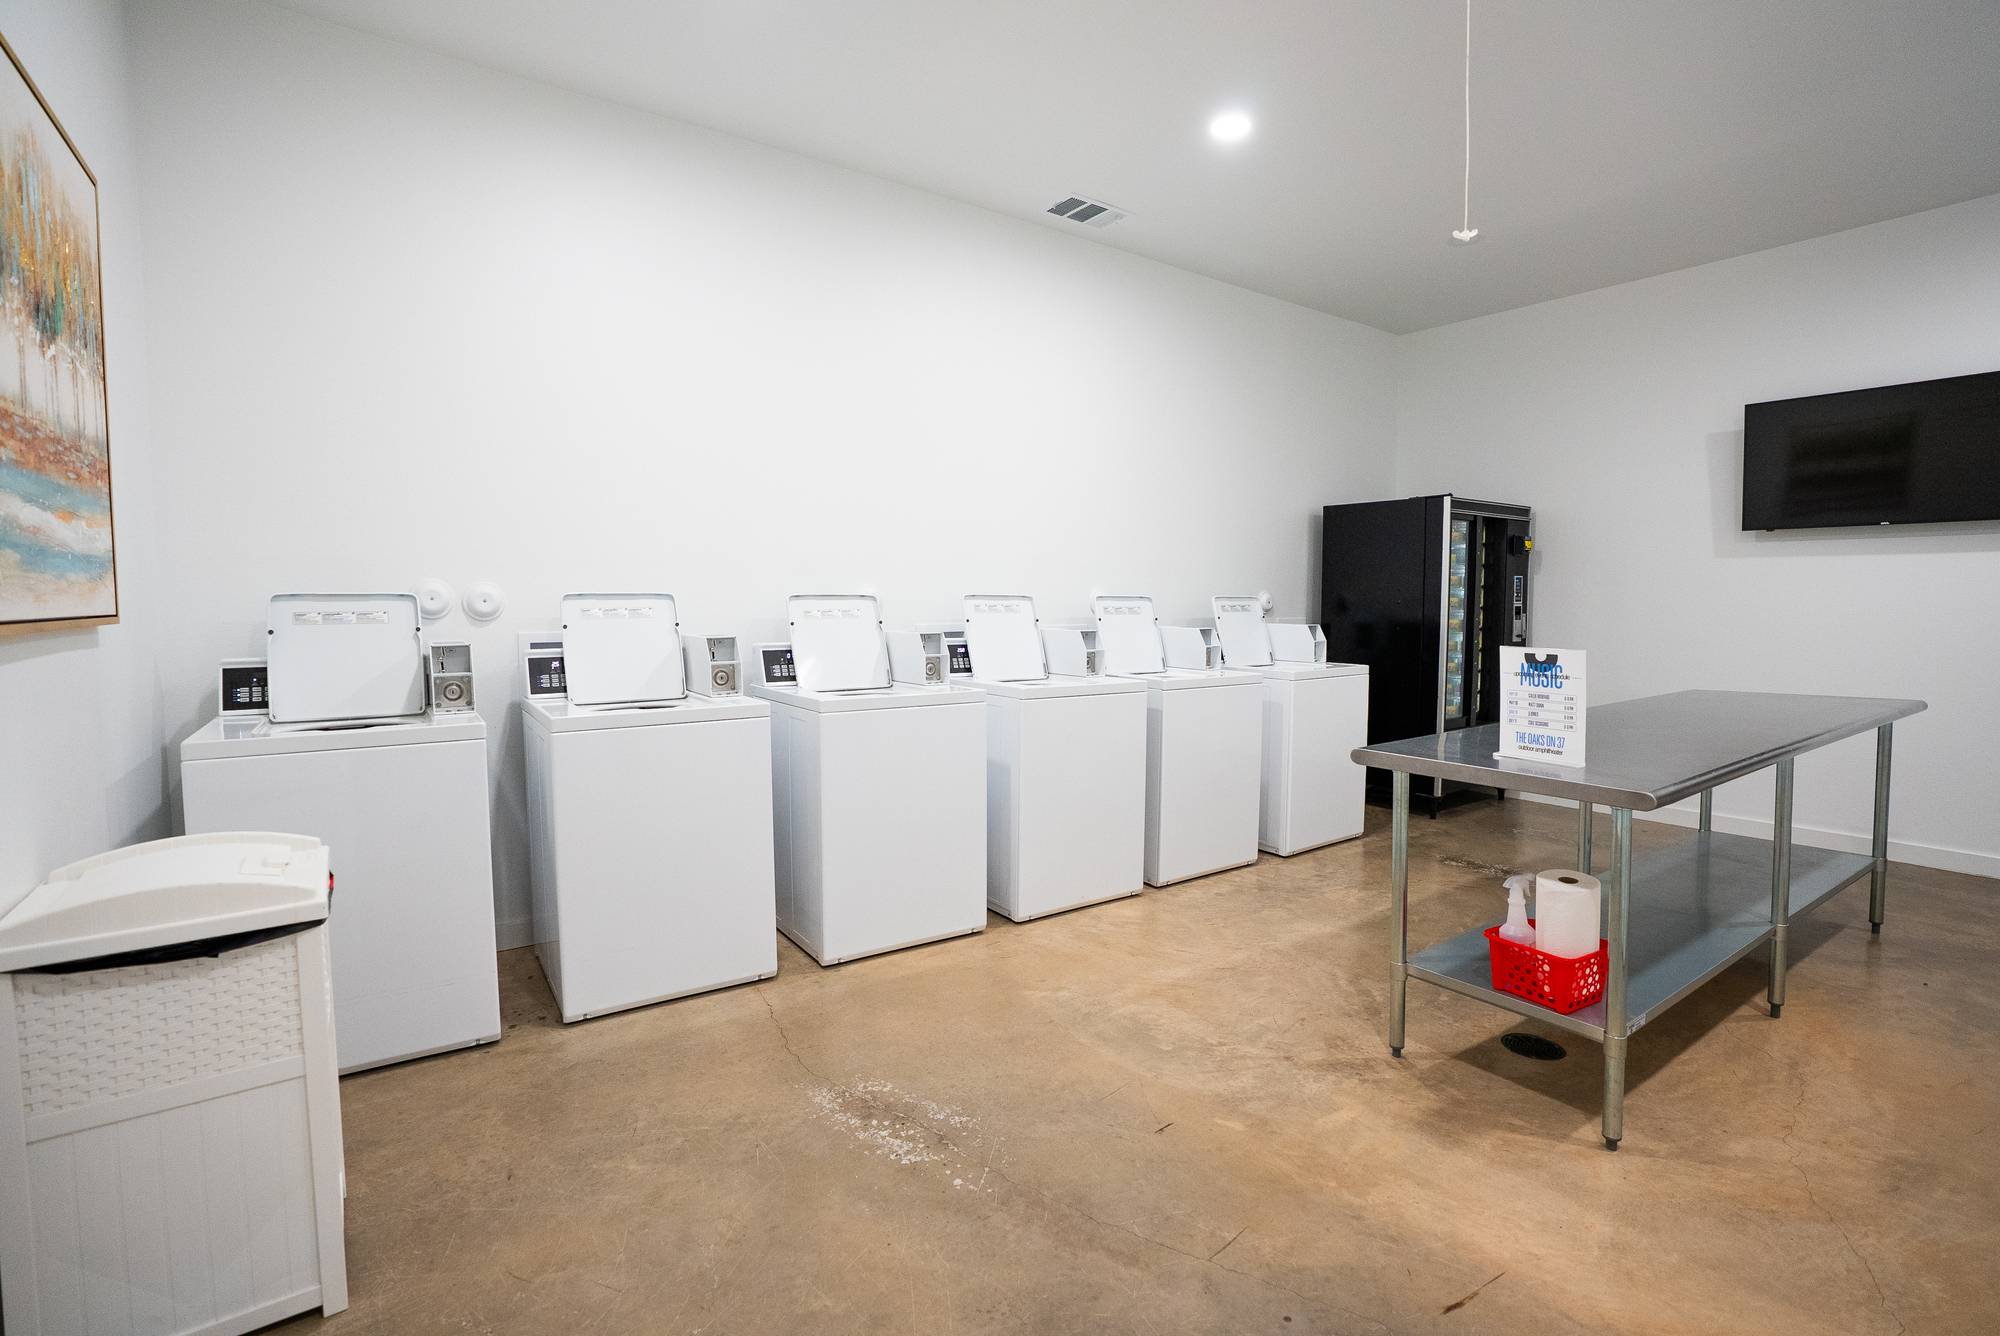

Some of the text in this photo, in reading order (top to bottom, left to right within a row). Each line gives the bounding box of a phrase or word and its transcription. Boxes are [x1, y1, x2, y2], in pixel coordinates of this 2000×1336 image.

[1520, 662, 1563, 689] MUSIC
[1516, 731, 1566, 749] THE OAKS ON 37
[1518, 744, 1563, 756] outdoor amphitheater
